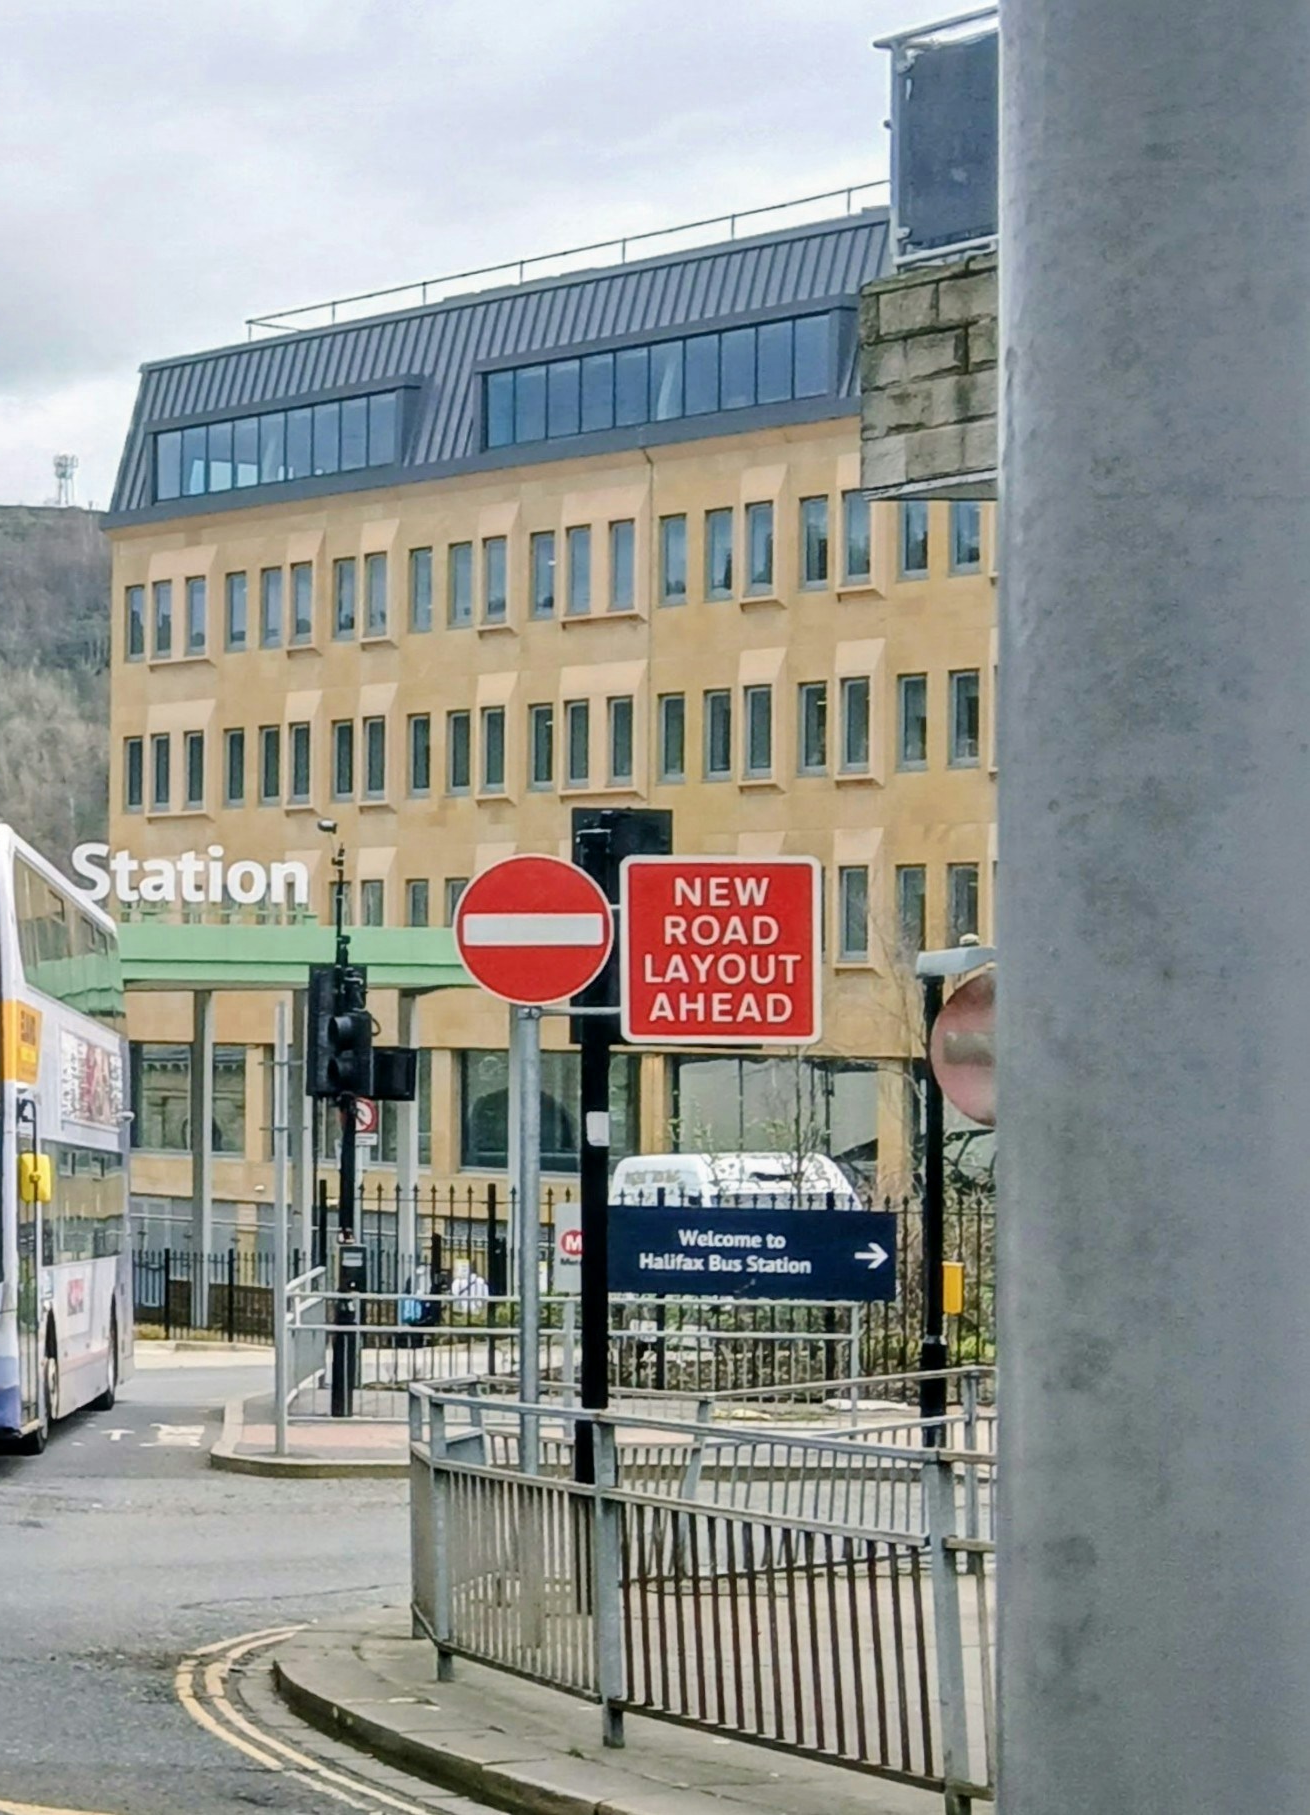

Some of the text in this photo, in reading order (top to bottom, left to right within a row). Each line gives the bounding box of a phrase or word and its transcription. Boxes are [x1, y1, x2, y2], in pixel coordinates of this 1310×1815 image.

[72, 842, 309, 904] Station
[675, 876, 769, 906] NEW
[664, 914, 779, 945] ROAD
[644, 953, 802, 984] LAYOUT
[649, 991, 793, 1023] AHEAD
[678, 1229, 787, 1249] Welcome to
[639, 1252, 813, 1275] Halifax Bus Station
